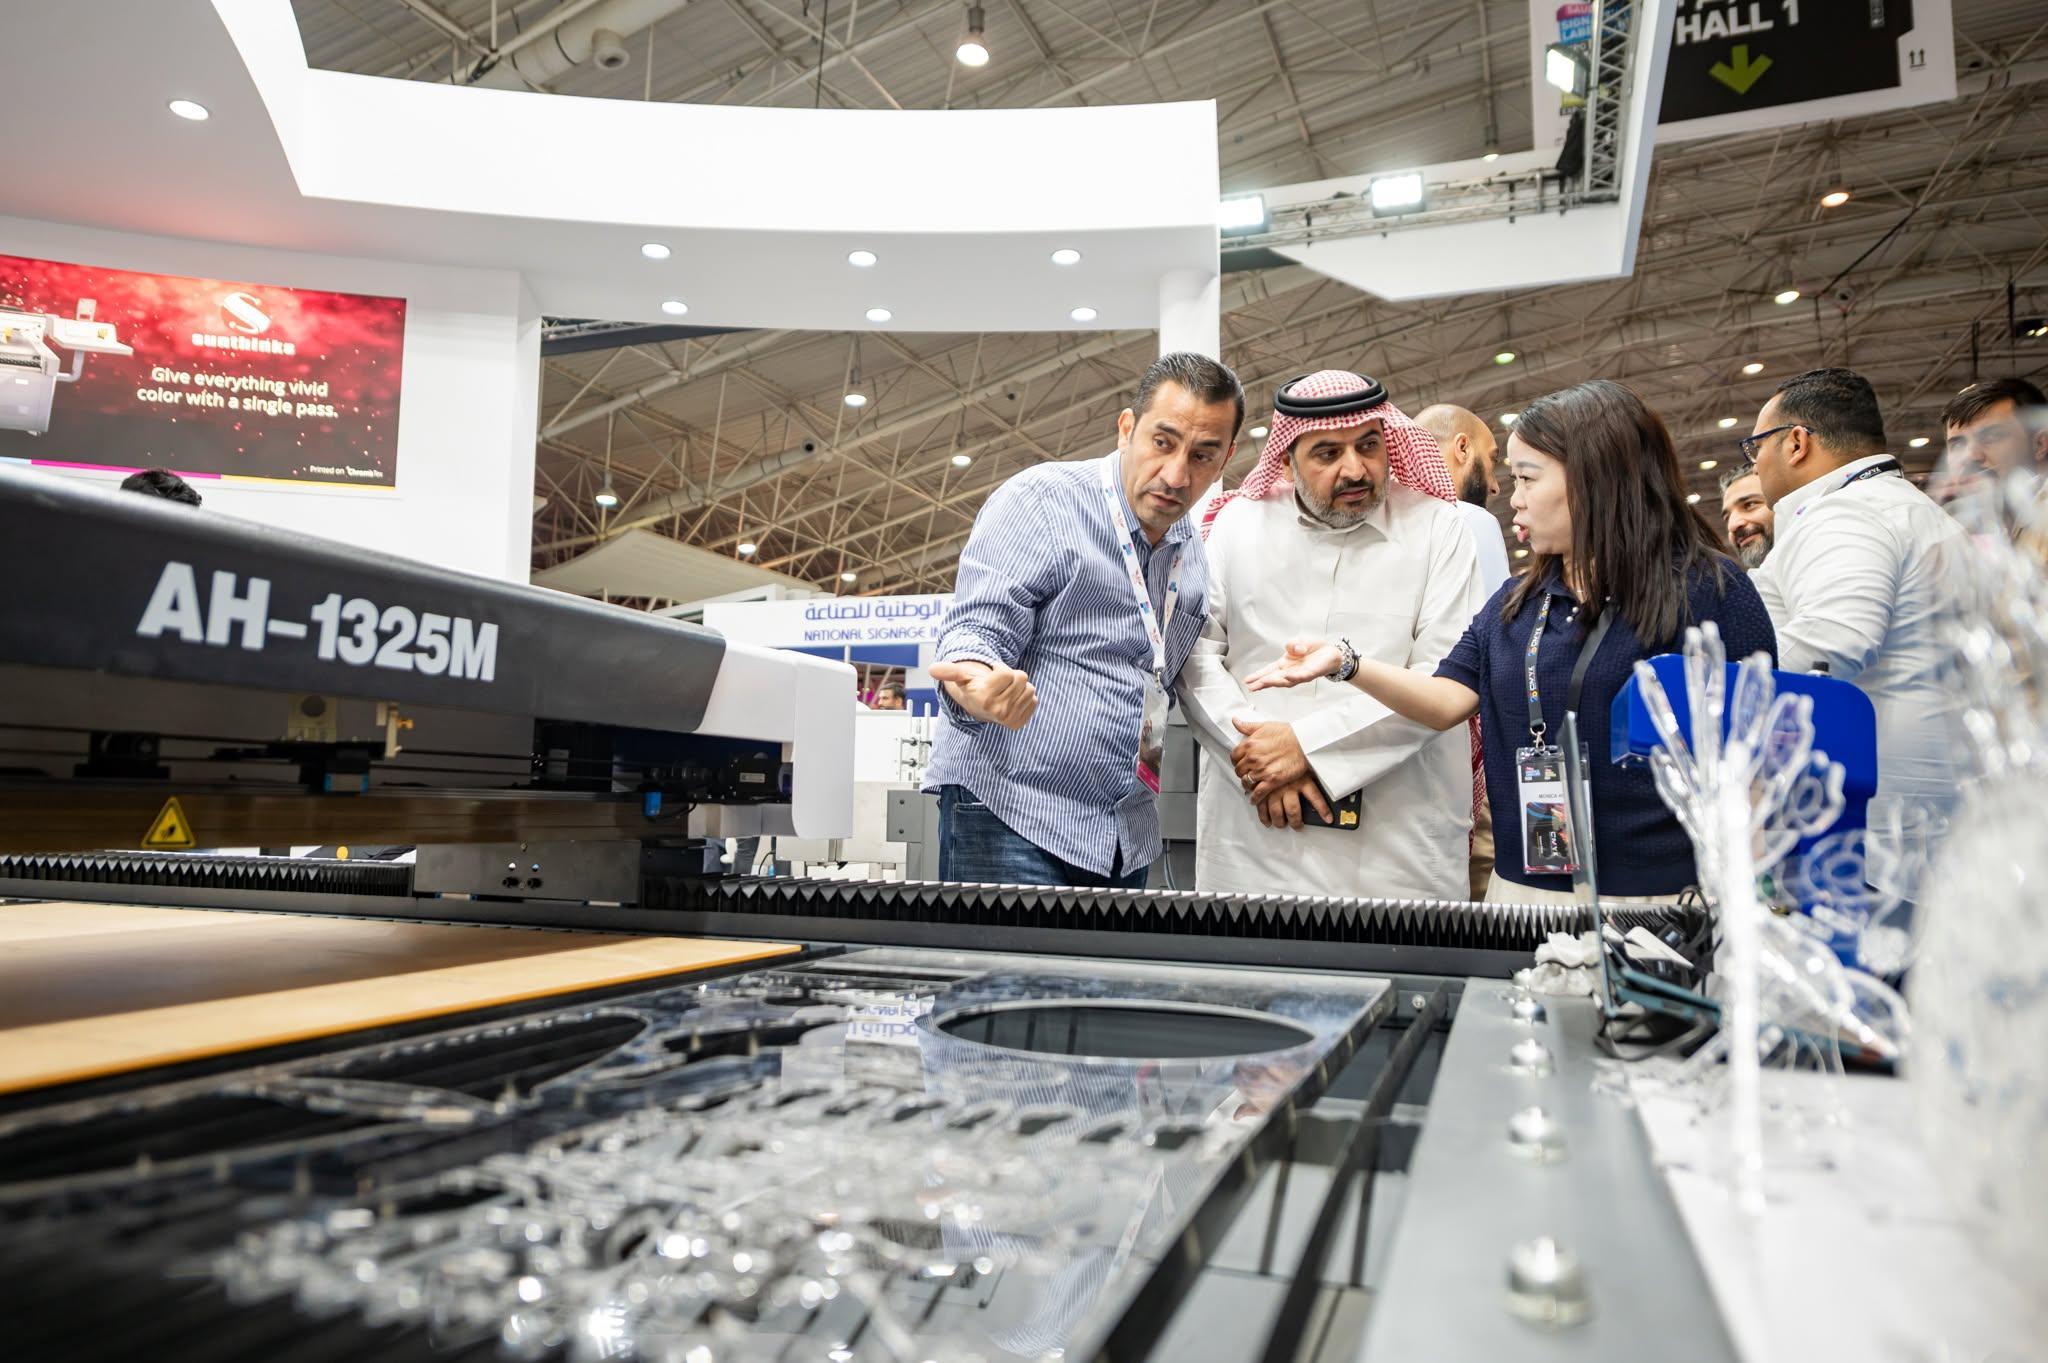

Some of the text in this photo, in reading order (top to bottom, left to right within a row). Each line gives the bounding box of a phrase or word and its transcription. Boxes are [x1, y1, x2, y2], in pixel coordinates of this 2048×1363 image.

[1675, 0, 1799, 45] HALL 1
[151, 366, 329, 398] Give everything vivid
[136, 386, 339, 419] color with a single pass.
[309, 465, 335, 475] Printed
[136, 560, 499, 683] AH-1325M
[805, 602, 870, 620] للصناعة
[875, 600, 941, 621] الوطنية
[804, 629, 863, 641] NATIONAL
[868, 626, 926, 640] SIGNAGE
